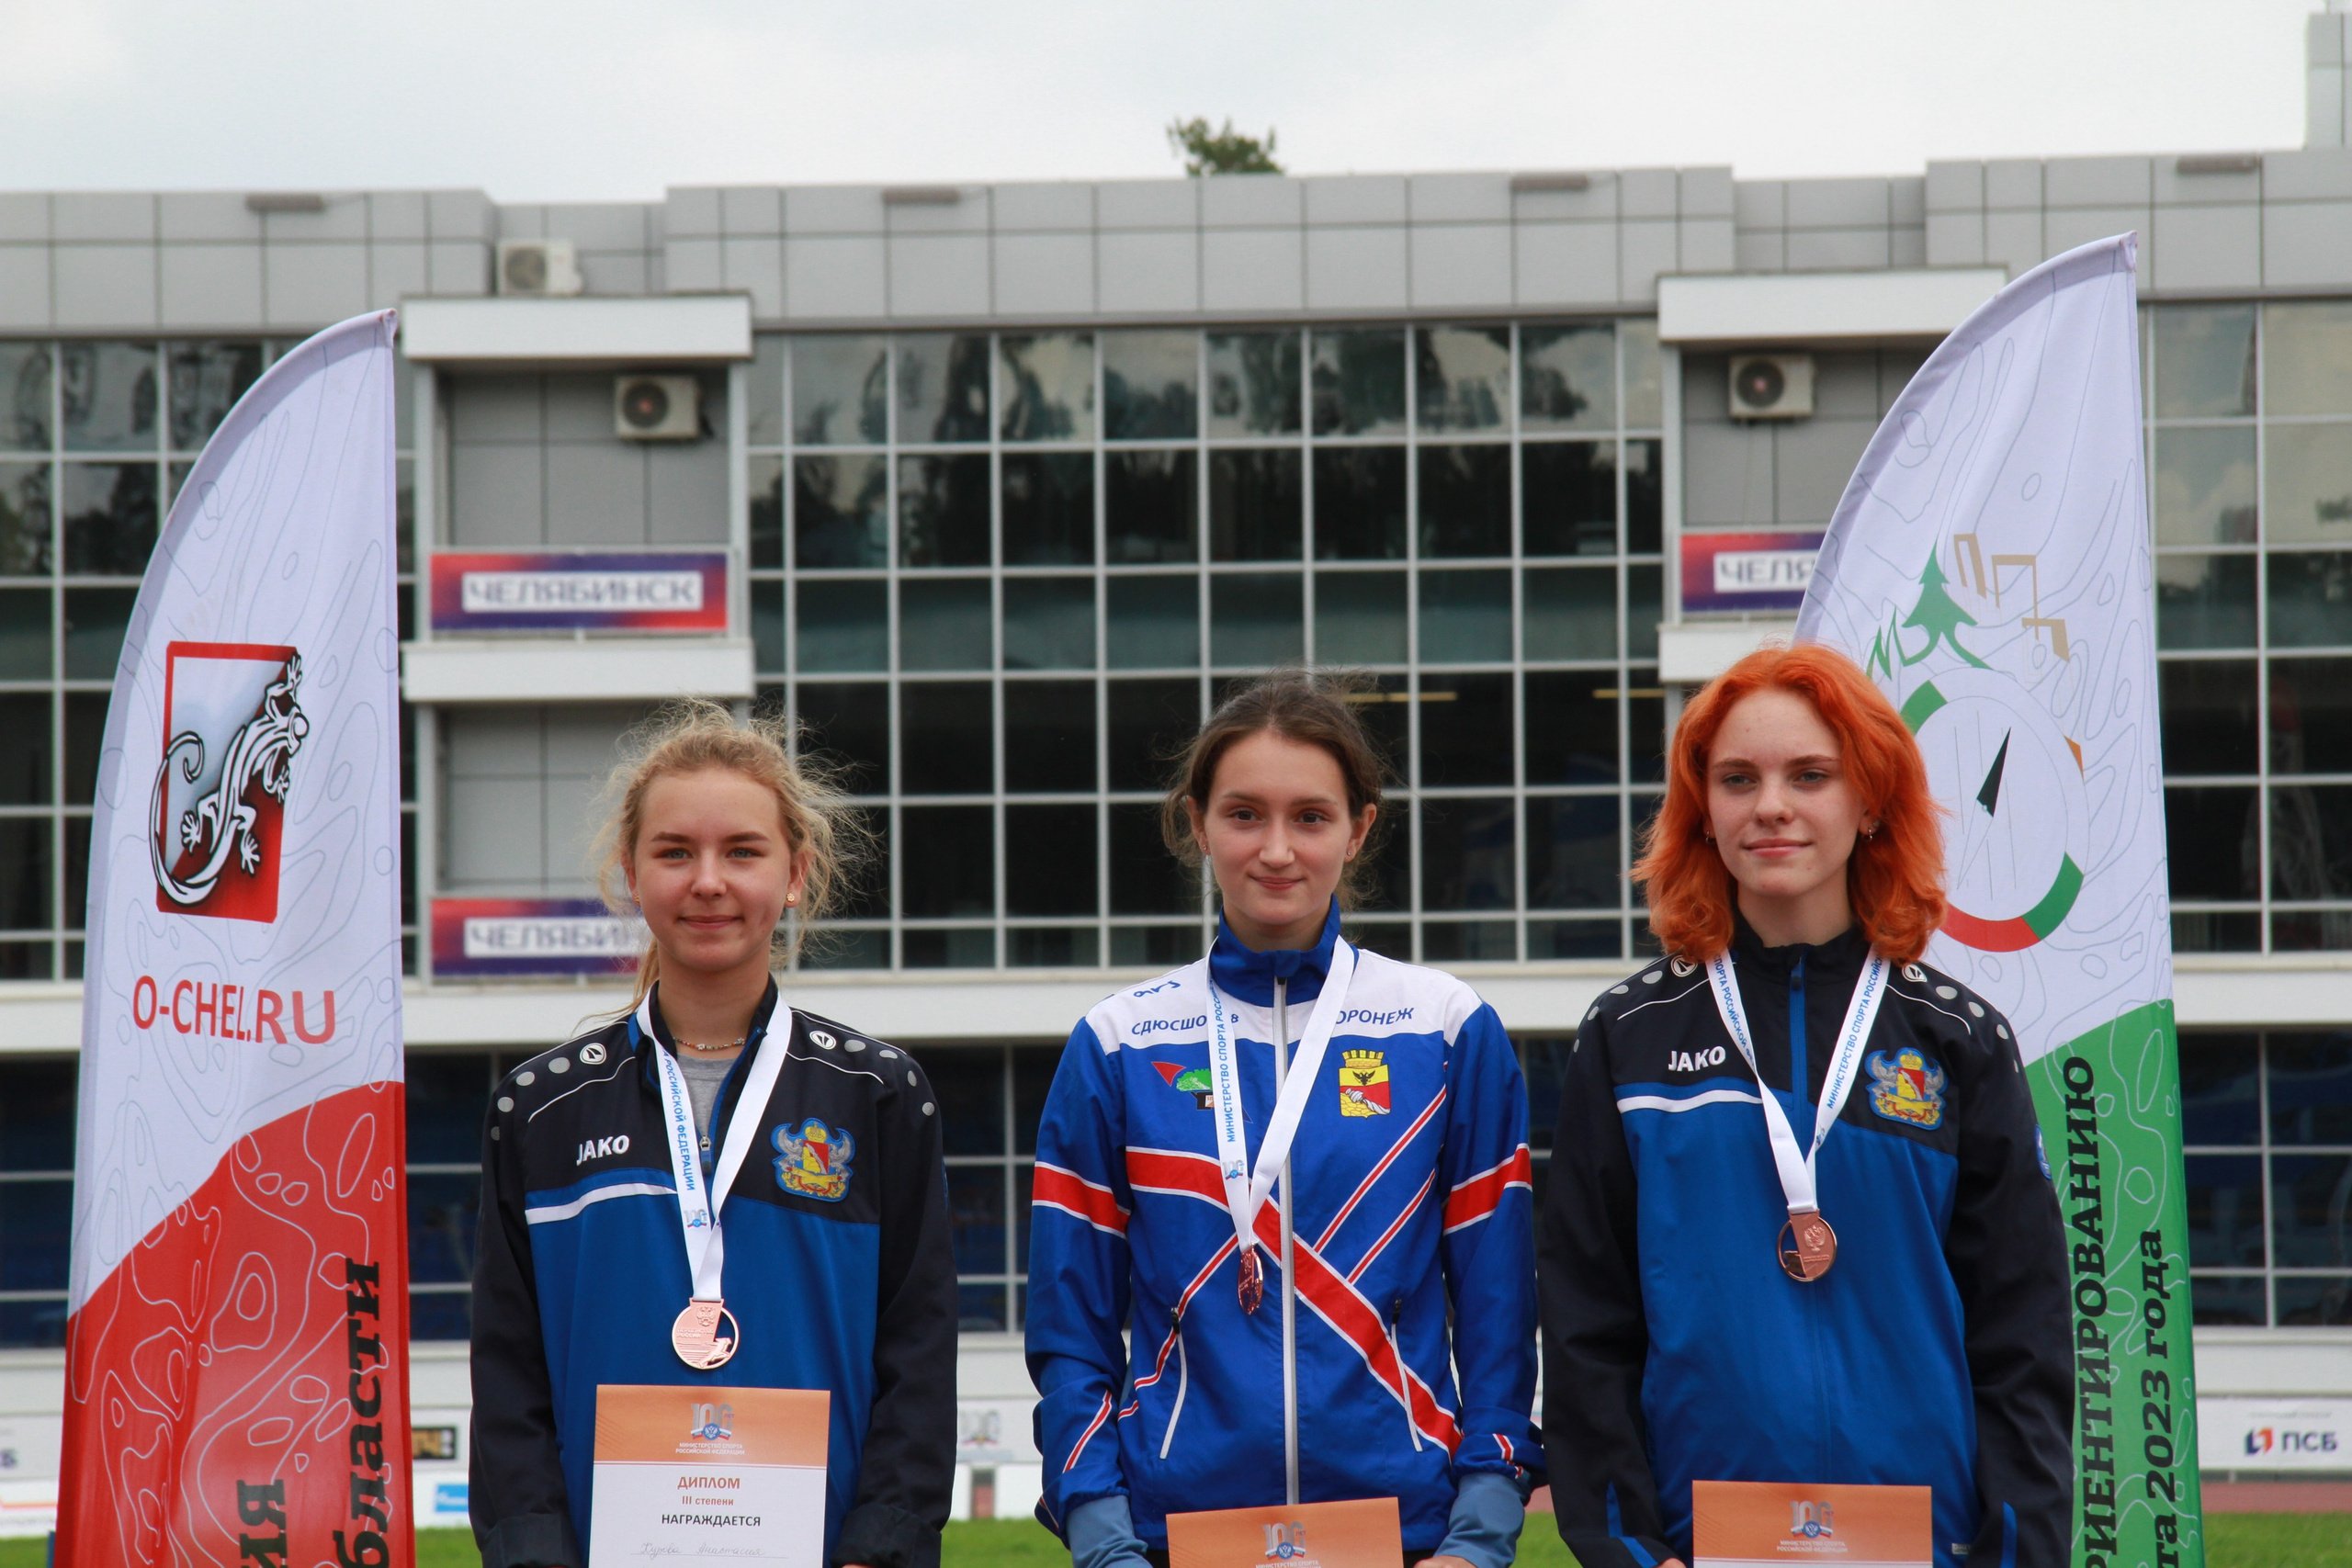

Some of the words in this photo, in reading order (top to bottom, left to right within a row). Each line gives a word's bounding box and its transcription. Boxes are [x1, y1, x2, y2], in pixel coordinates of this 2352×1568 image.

[469, 579, 695, 603] ЧЕЛЯБИНСК
[133, 975, 335, 1044] O-CHEL.RU
[1722, 986, 1747, 1048] РОССИЙСКОЙ
[1217, 1023, 1227, 1061] СПОРТА
[1668, 1045, 1726, 1072] JAKO
[1826, 1032, 1858, 1110] МИНИСТЕРСТВО
[1851, 998, 1871, 1034] СПОРТА
[664, 1057, 687, 1122] РОССИЙСКОЙ
[676, 1124, 695, 1190] ФЕДЕРАЦИИ
[1219, 1064, 1236, 1143] МИНИСТЕРСТВО
[576, 1134, 630, 1167] JAKO
[2140, 1229, 2171, 1359] года
[333, 1258, 390, 1568] бласти
[2140, 1369, 2176, 1503] 2023
[2281, 1430, 2338, 1452] ПСБ
[677, 1476, 741, 1490] ДИПЛОМ
[682, 1495, 692, 1506] III
[695, 1496, 734, 1506] степени
[662, 1514, 761, 1528] НАГРАЖДАЕТСЯ
